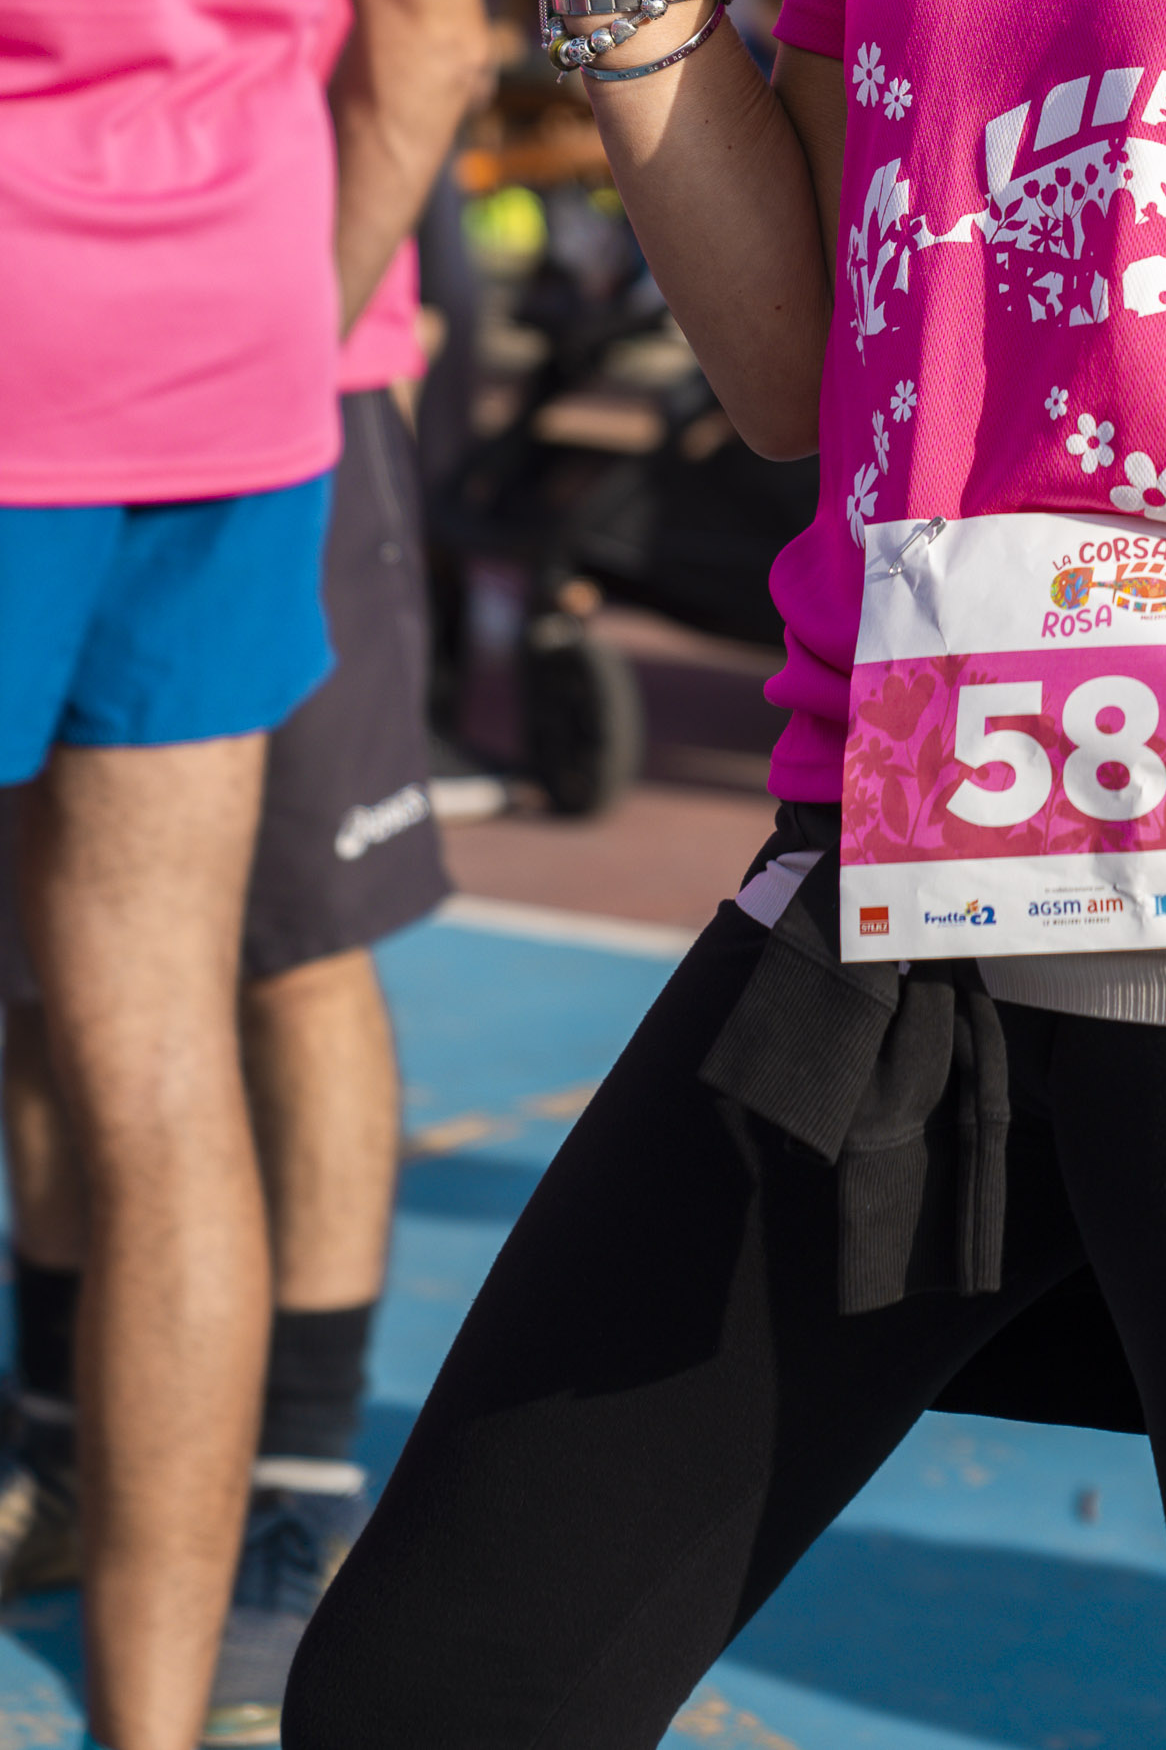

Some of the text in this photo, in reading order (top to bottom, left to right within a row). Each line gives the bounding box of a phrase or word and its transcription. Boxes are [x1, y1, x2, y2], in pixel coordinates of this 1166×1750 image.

[1053, 555, 1072, 571] LA
[1041, 604, 1112, 638] ROSA
[925, 911, 966, 925] Frutta
